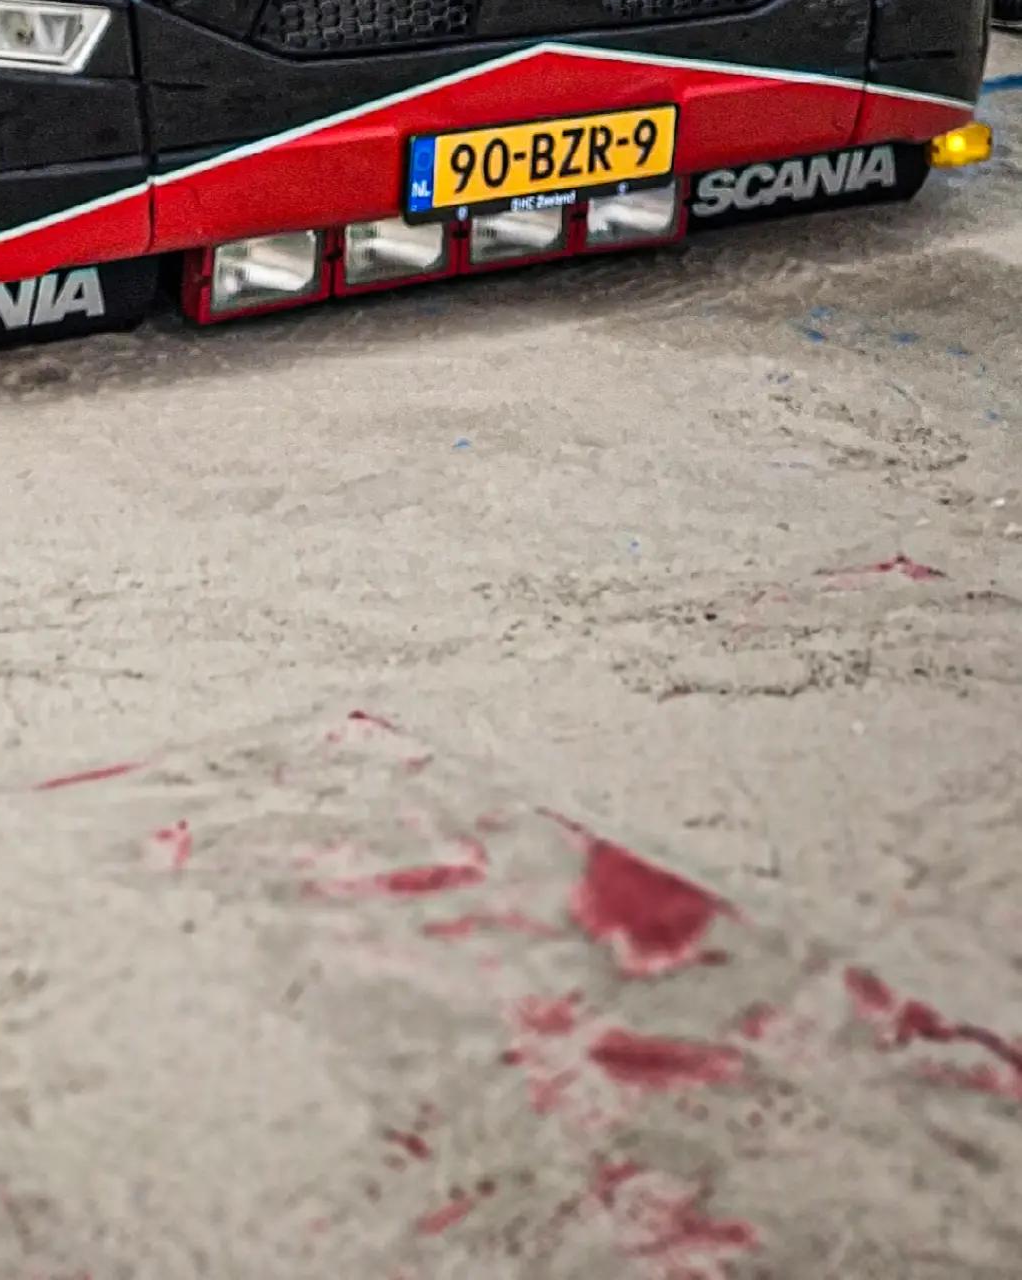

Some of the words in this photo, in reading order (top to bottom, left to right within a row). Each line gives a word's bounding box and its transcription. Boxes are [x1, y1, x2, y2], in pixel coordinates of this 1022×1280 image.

[411, 179, 432, 198] NL
[449, 118, 658, 194] 90-BZR-9
[691, 144, 897, 218] SCANIA
